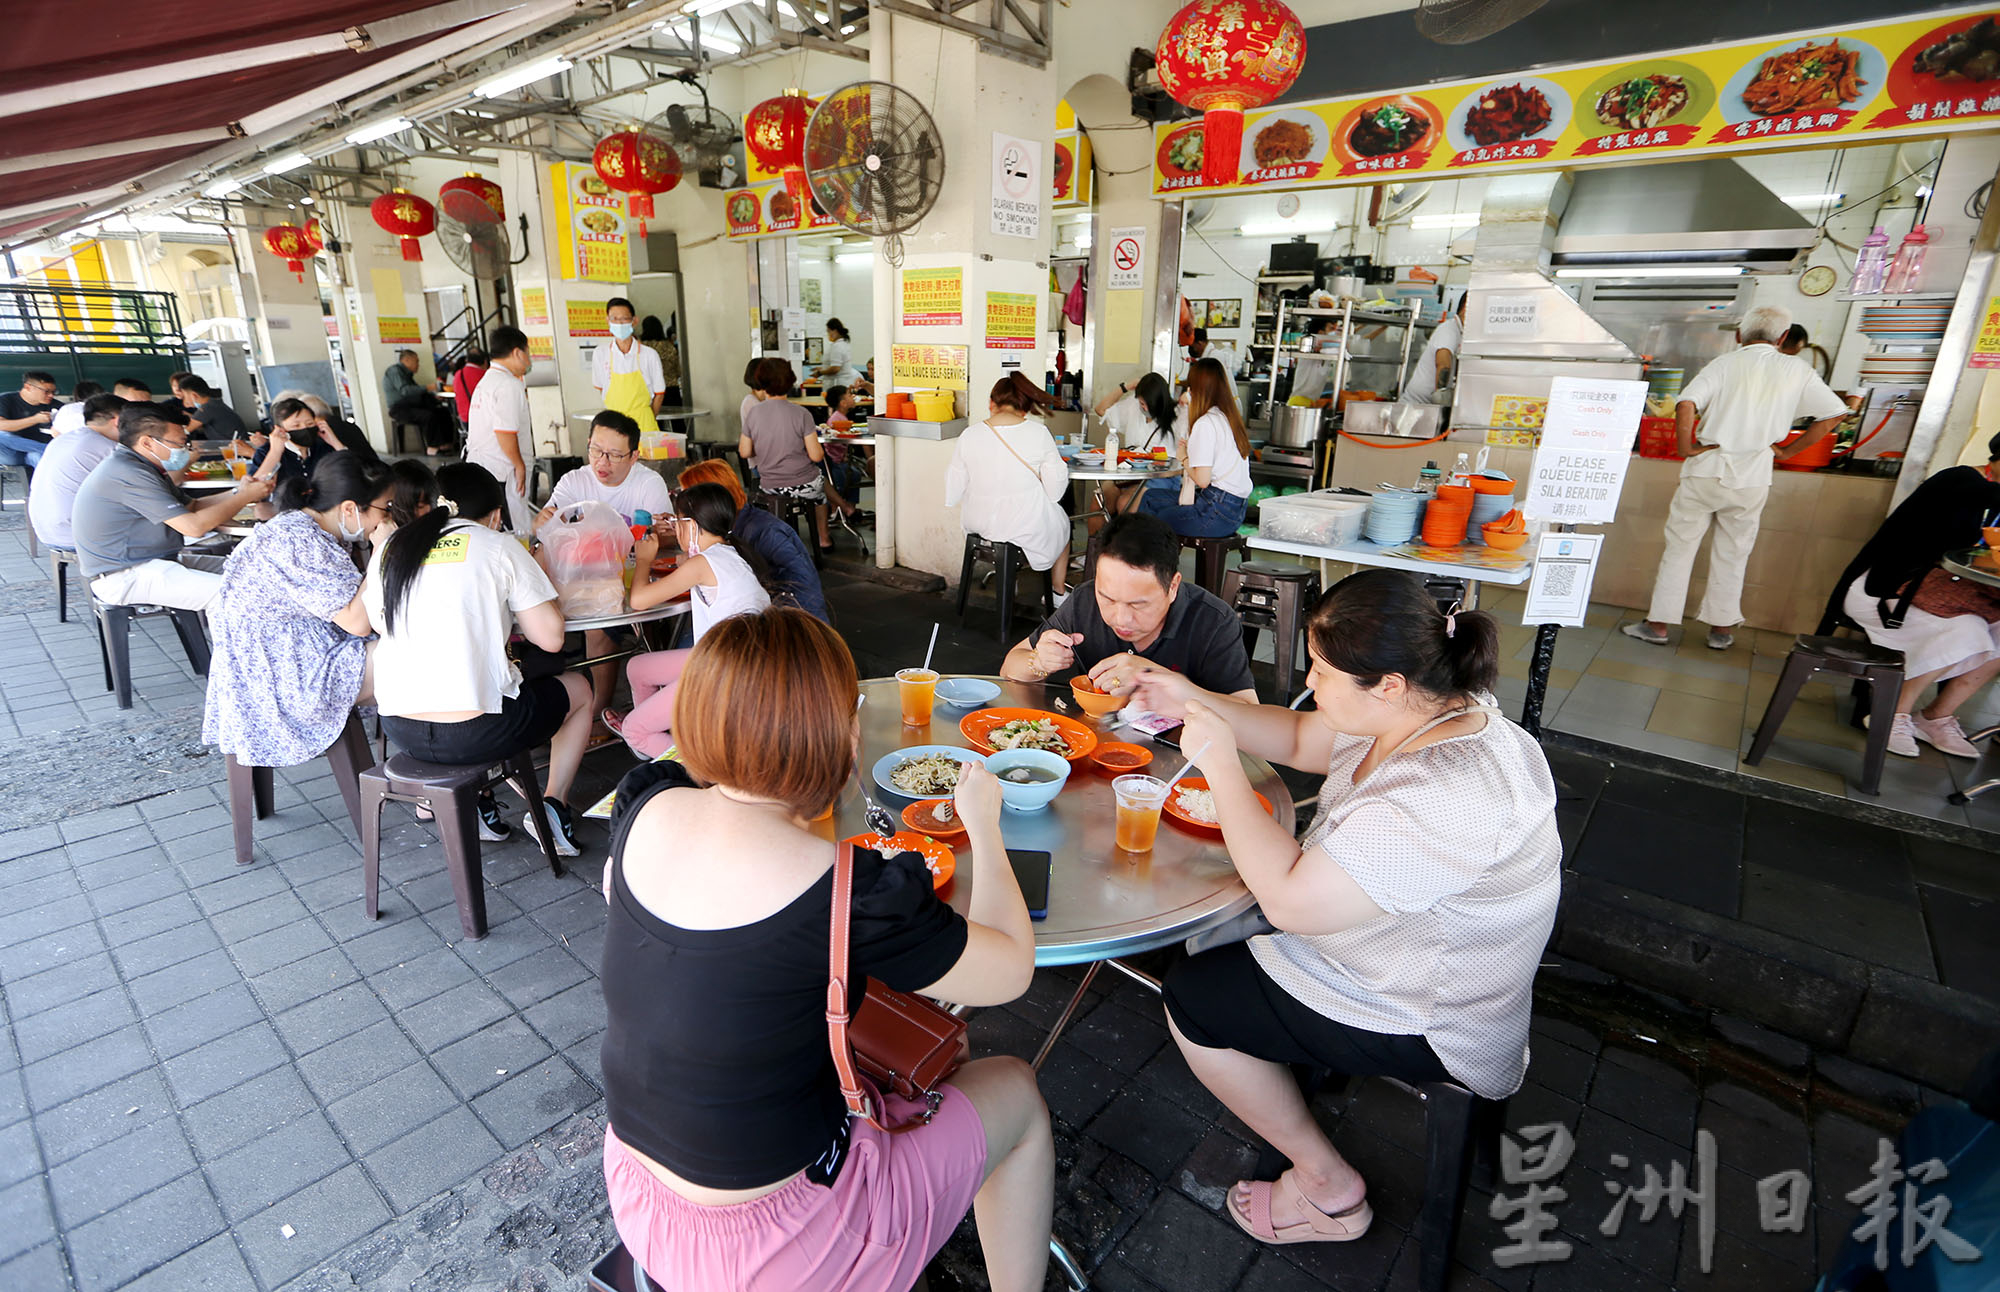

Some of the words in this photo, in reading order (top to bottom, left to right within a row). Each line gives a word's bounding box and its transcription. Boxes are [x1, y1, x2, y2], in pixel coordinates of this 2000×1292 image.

[993, 211, 1003, 220] NO
[1006, 212, 1038, 225] SMOKING
[894, 347, 965, 367] 辣椒酱自便
[894, 366, 911, 377] CHILLI
[912, 366, 928, 378] SAUCE
[930, 366, 966, 380] SELF-SERVICE
[1596, 406, 1613, 415] Only
[1591, 430, 1606, 438] Only
[1558, 456, 1607, 470] PLEASE
[1540, 469, 1582, 482] QUEUE
[1584, 472, 1617, 484] HERE
[1541, 485, 1562, 498] SILA
[1565, 486, 1608, 501] BERATUR
[1552, 502, 1588, 517] 请排队
